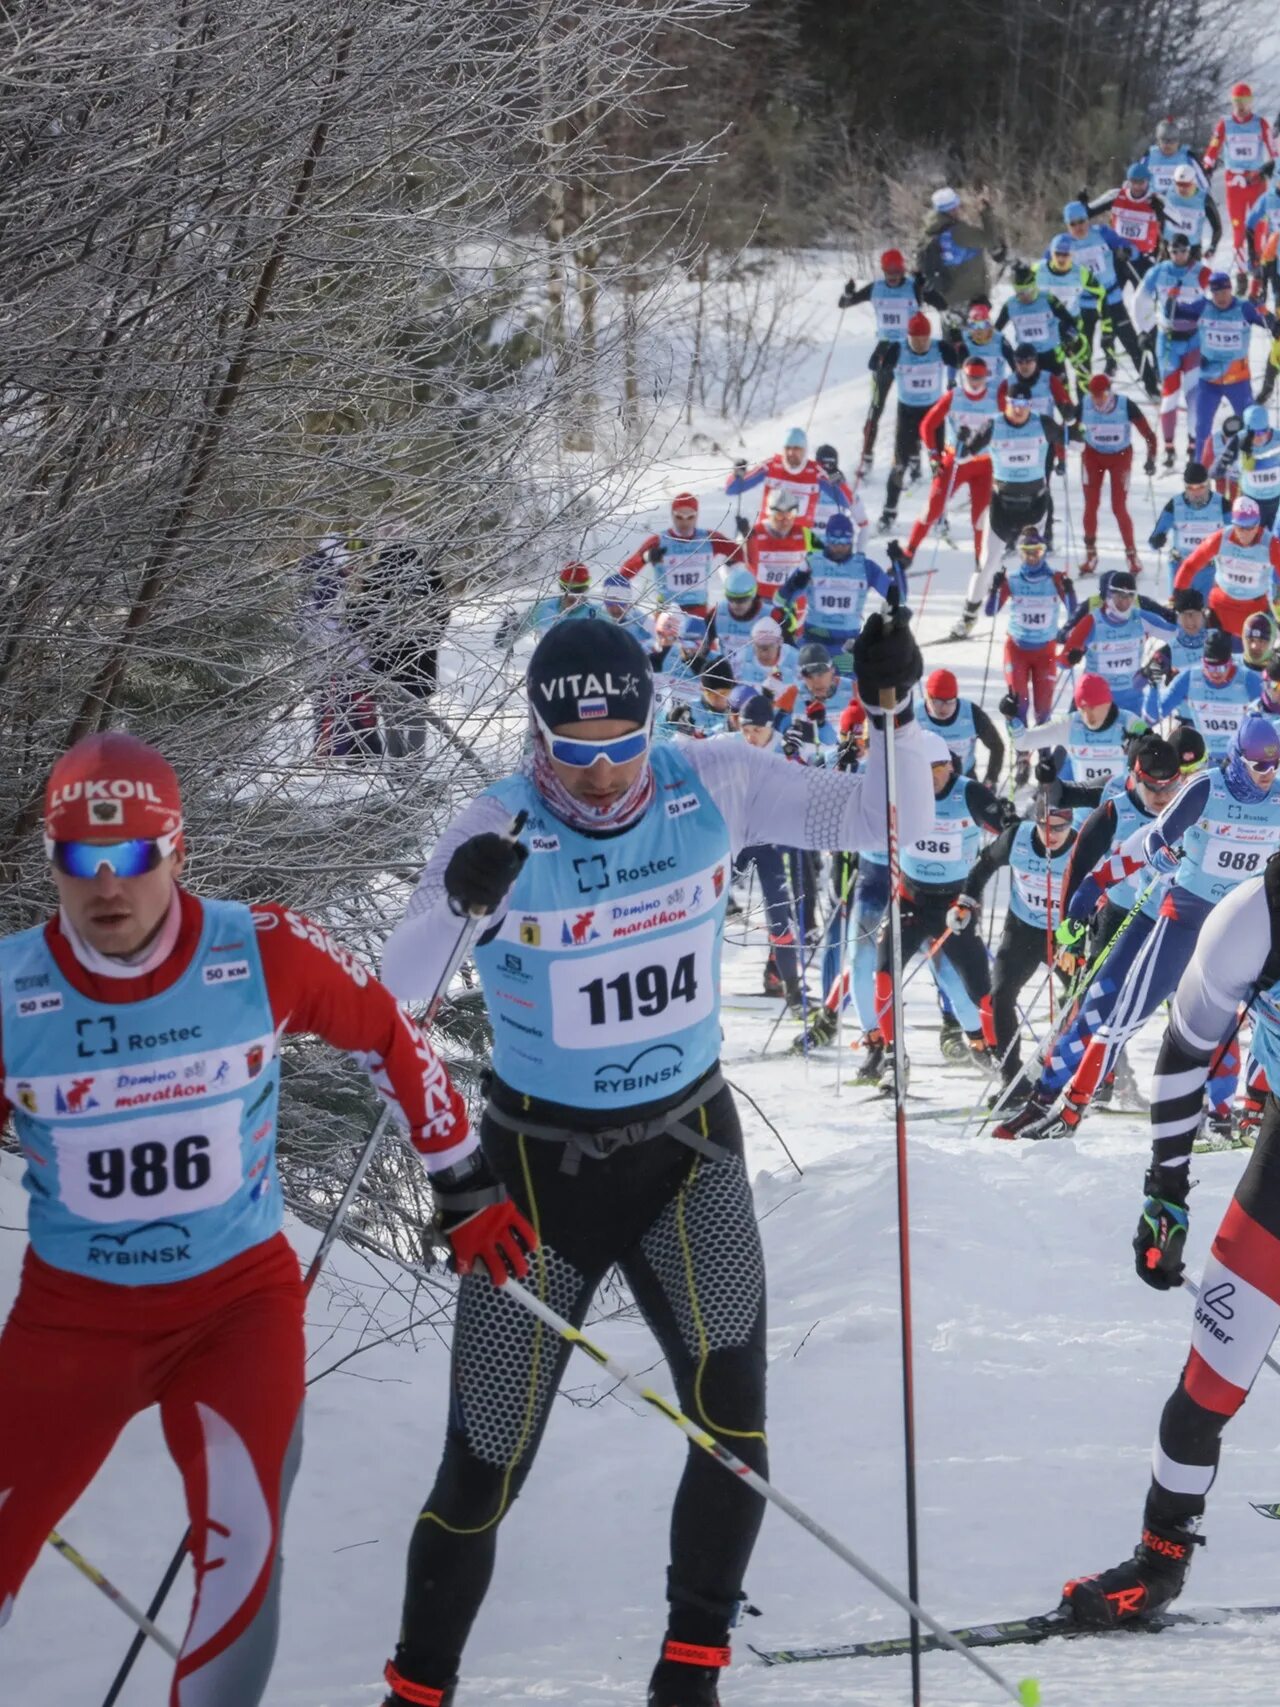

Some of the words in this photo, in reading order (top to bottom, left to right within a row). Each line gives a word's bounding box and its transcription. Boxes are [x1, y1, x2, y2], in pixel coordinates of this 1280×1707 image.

[540, 671, 620, 702] VITAL
[51, 779, 162, 808] LUKOIL
[616, 854, 678, 884] Rostec
[1217, 849, 1262, 872] 988
[611, 899, 662, 921] Demino
[612, 907, 688, 938] marathon
[205, 969, 225, 982] 50
[578, 951, 698, 1027] 1194
[19, 1001, 38, 1014] 50
[127, 1023, 203, 1052] Rostec
[115, 1069, 178, 1090] Demino
[593, 1061, 684, 1094] RYBINSK
[113, 1082, 209, 1110] marathon
[86, 1133, 212, 1201] 986
[86, 1244, 193, 1267] RYBINSK
